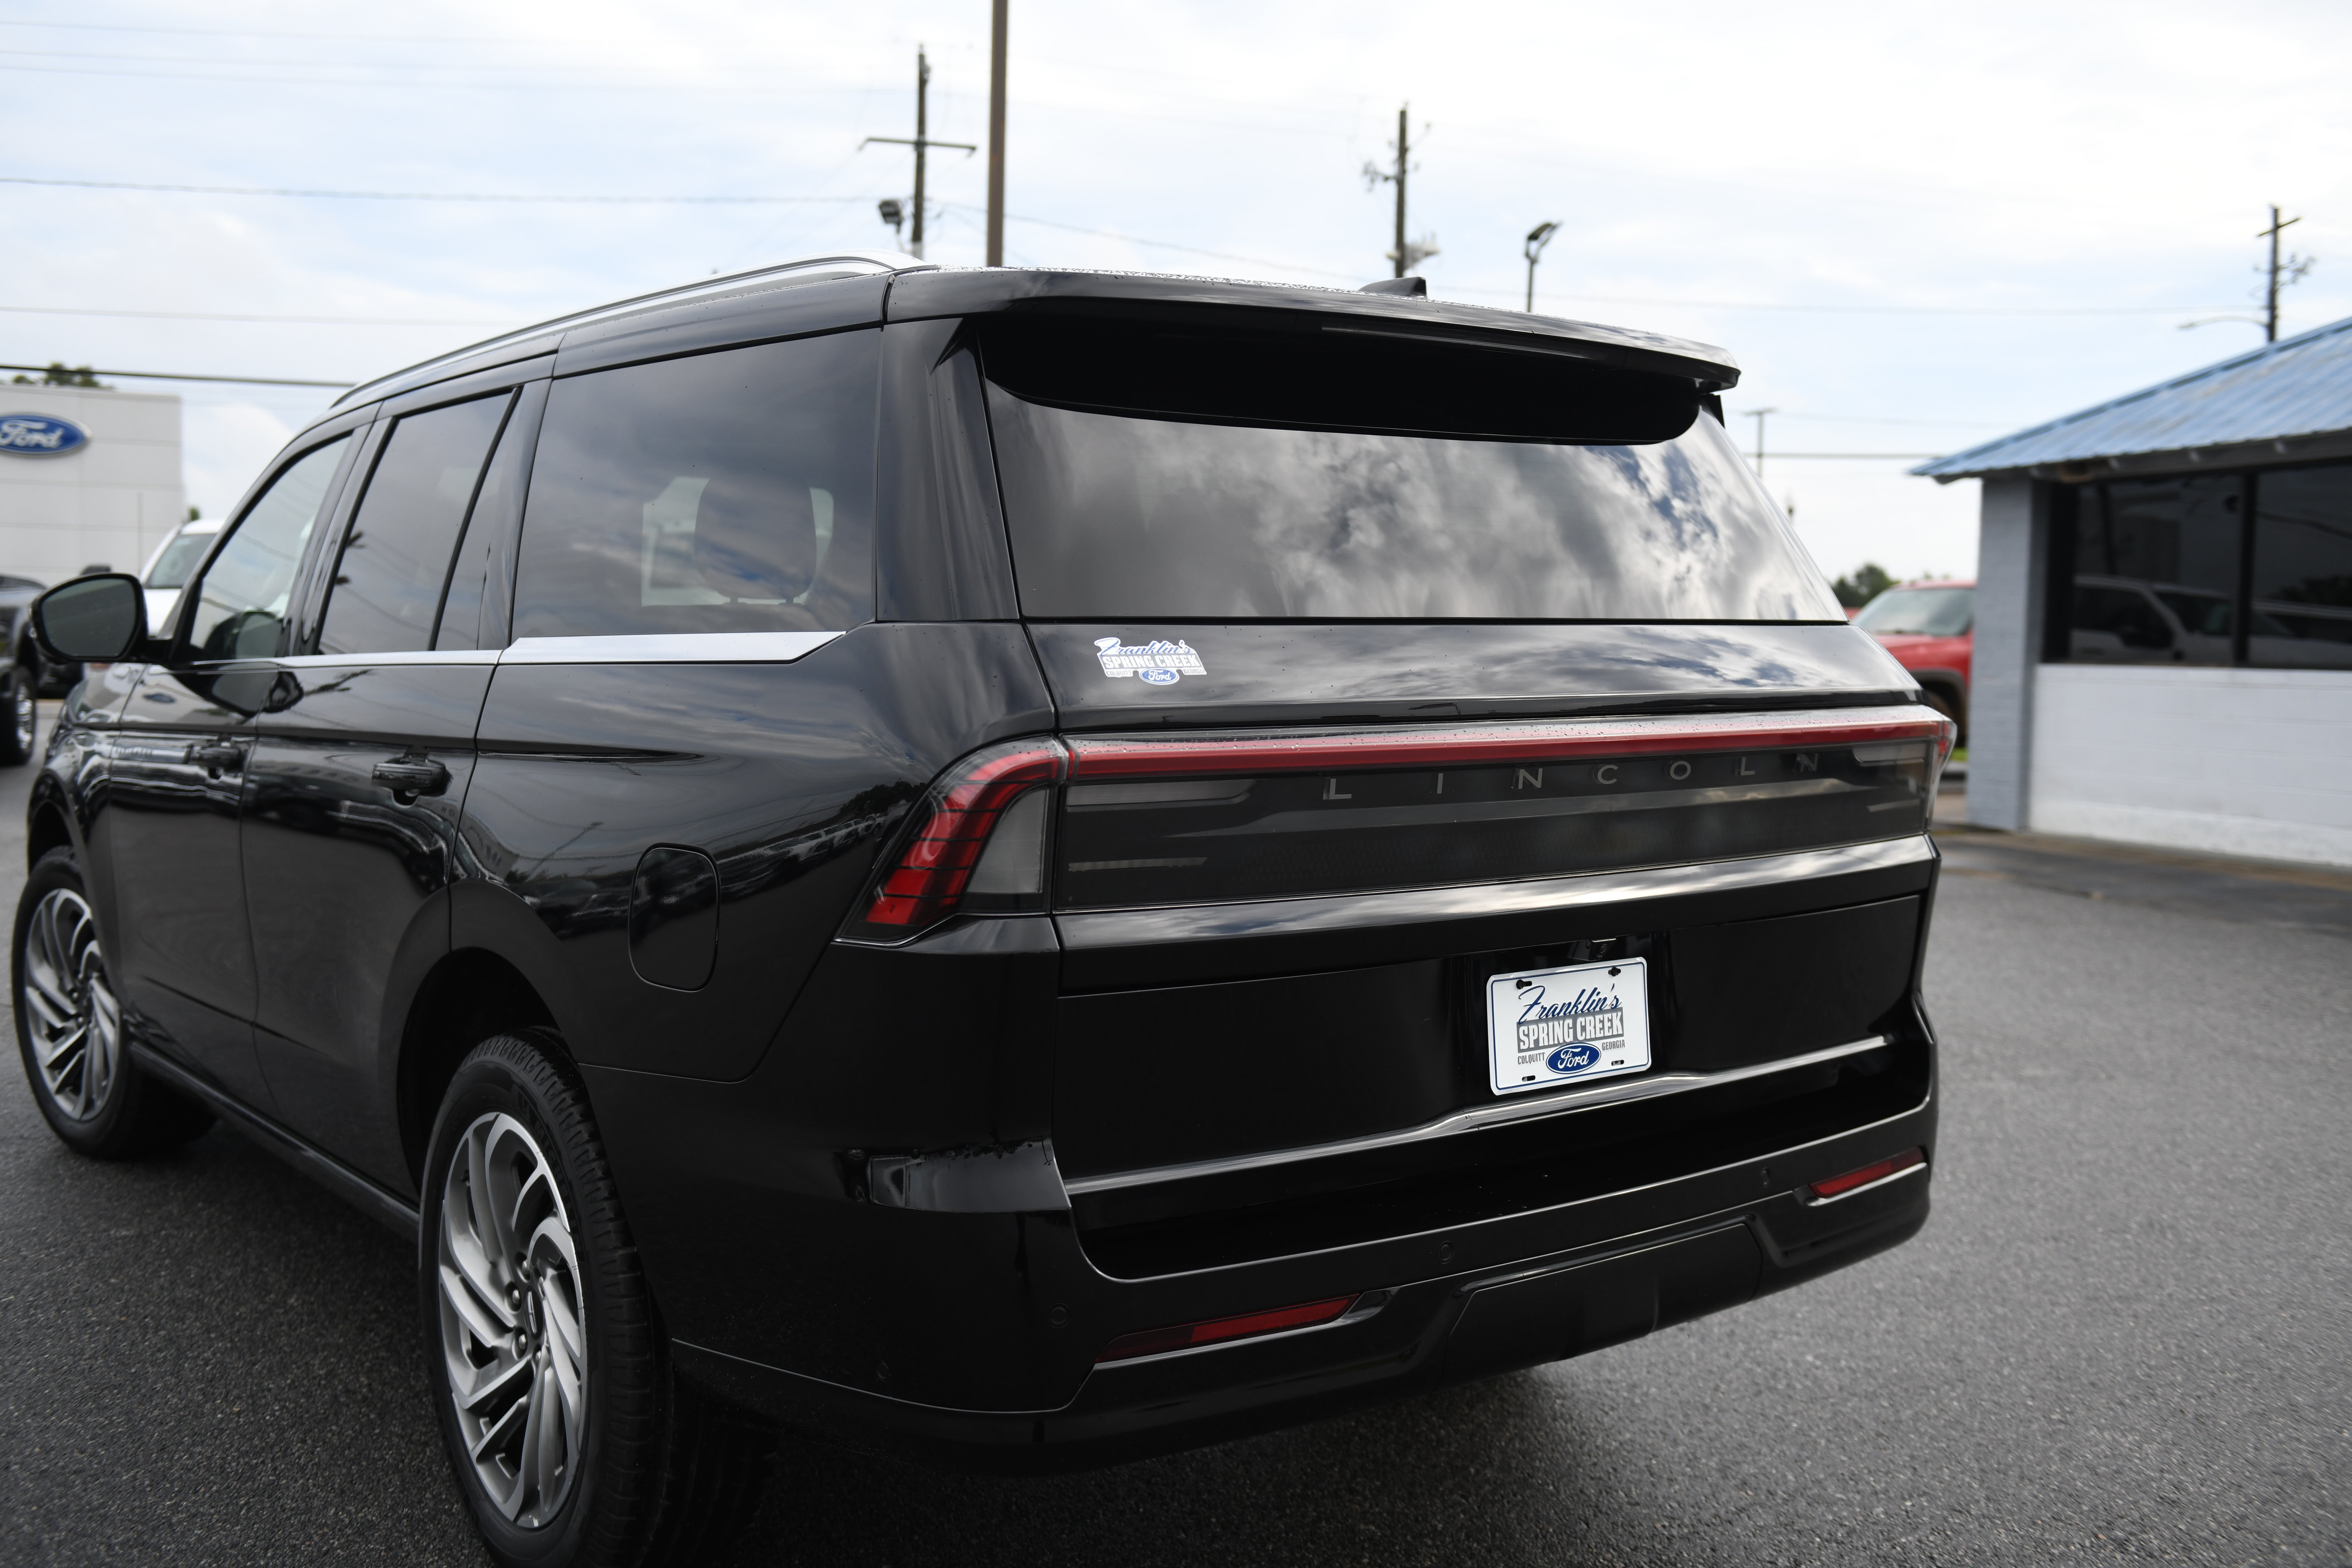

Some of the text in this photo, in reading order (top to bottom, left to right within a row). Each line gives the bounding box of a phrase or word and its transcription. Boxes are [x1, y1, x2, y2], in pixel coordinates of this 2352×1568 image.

[0, 419, 64, 448] Ford
[1096, 638, 1192, 656] Franklin's
[1102, 655, 1200, 668] SPRING CREEK
[1148, 670, 1172, 681] Ford
[1323, 752, 1819, 800] LINCOLN
[1518, 982, 1622, 1025] Franklin's
[1519, 1011, 1623, 1049] SPRING CREEK
[1601, 1039, 1625, 1051] GEORGIA
[1517, 1052, 1546, 1065] COLQUITT
[1557, 1047, 1589, 1069] Ford
[533, 1120, 583, 1252] MICHELIN
